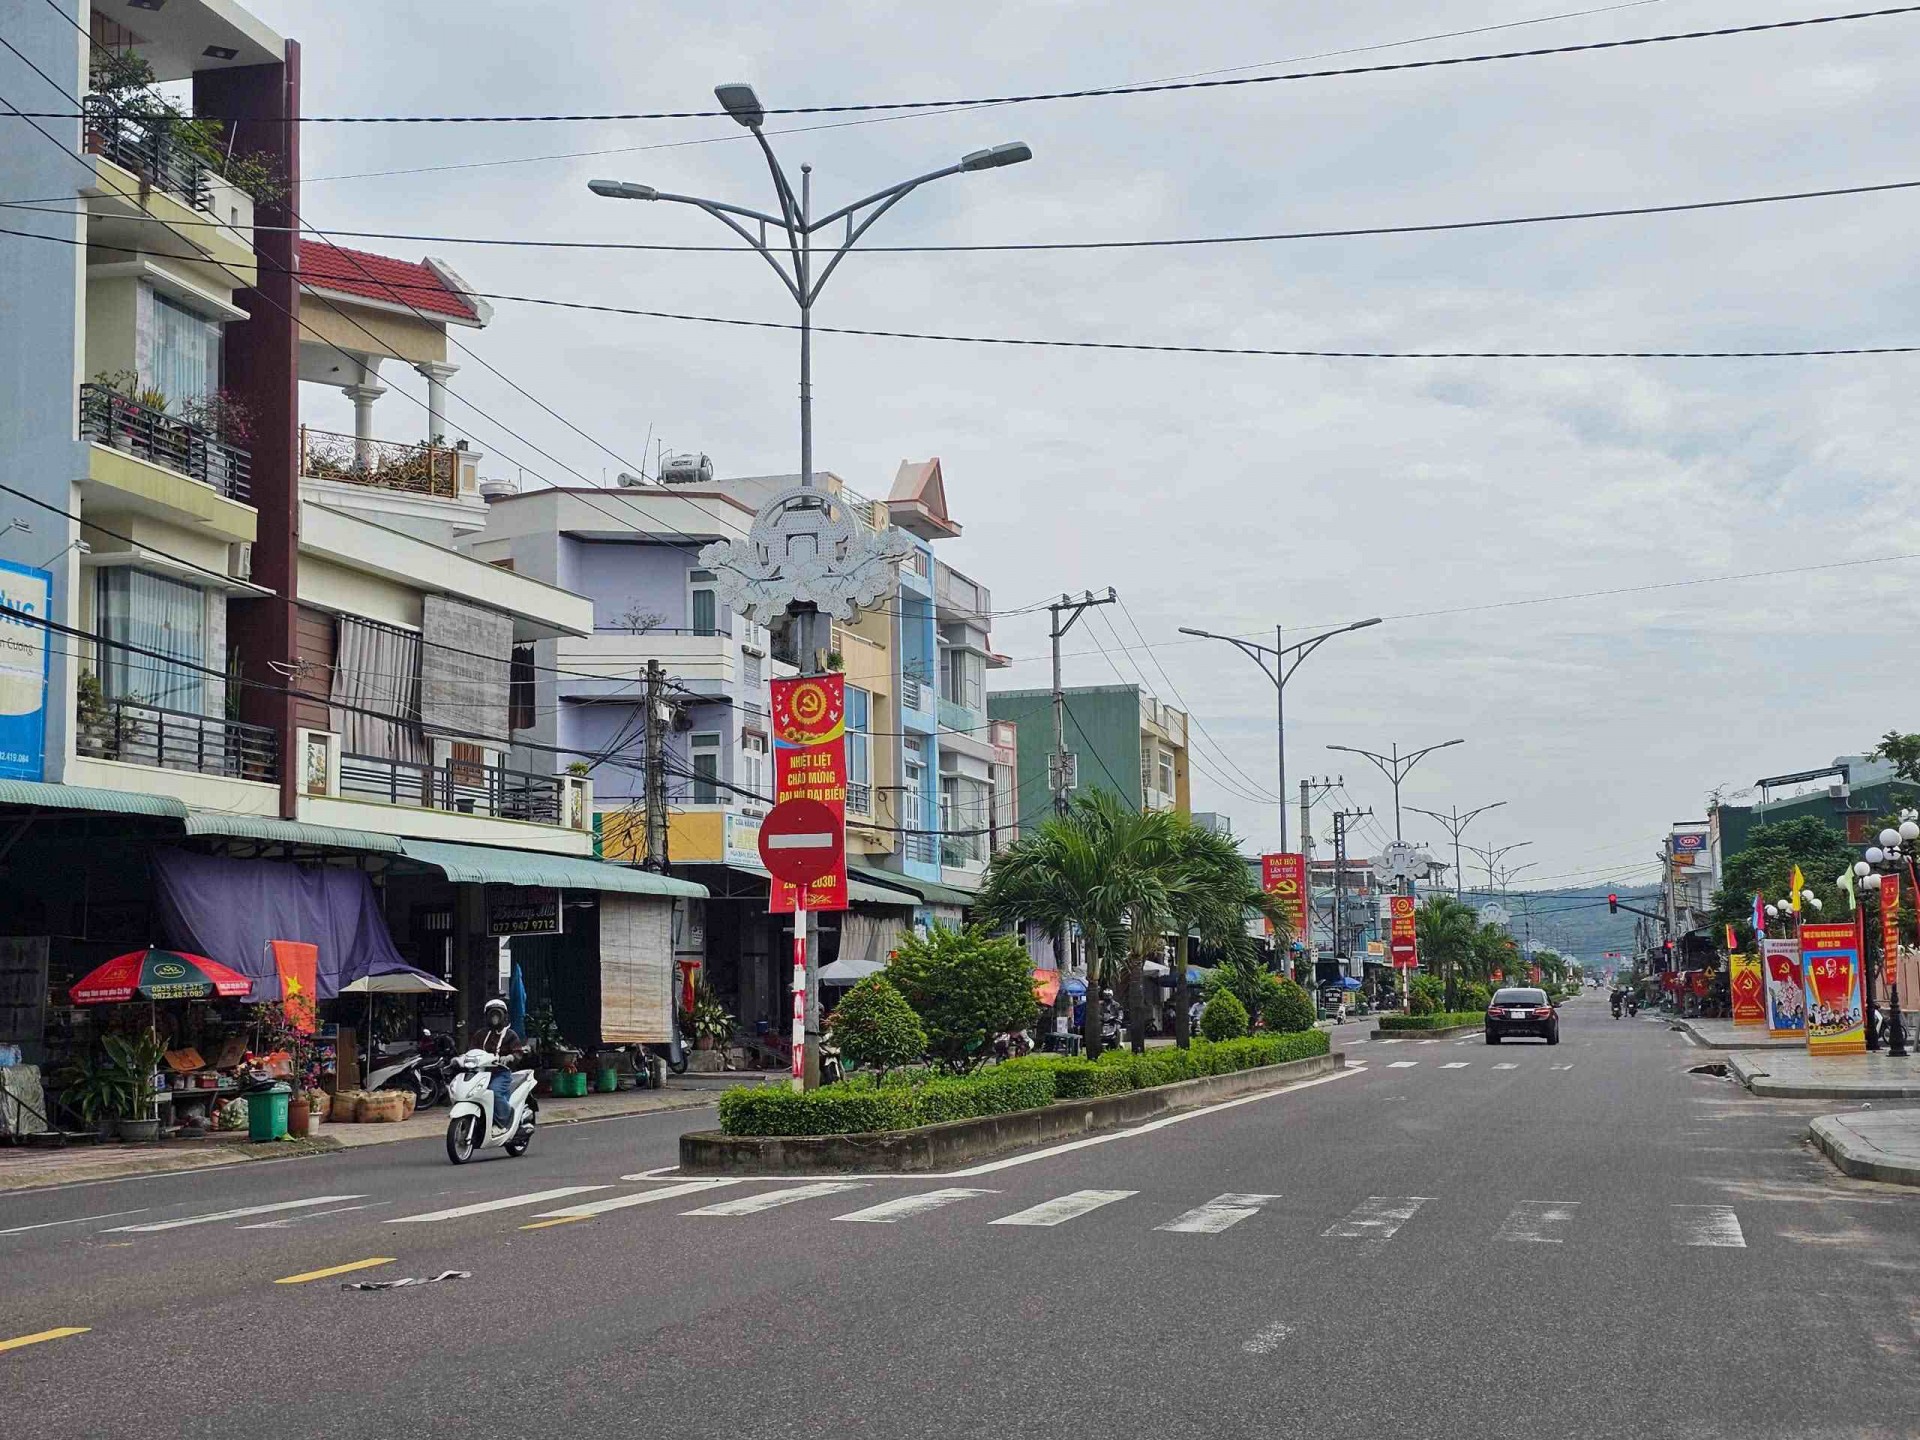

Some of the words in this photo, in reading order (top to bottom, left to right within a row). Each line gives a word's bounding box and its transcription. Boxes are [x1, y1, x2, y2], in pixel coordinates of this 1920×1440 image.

[790, 752, 811, 770] NHIỆT
[813, 751, 831, 769] LIỆT
[787, 770, 806, 786] CHÀO
[808, 769, 836, 784] MỪNG
[824, 783, 845, 801] BIỂU
